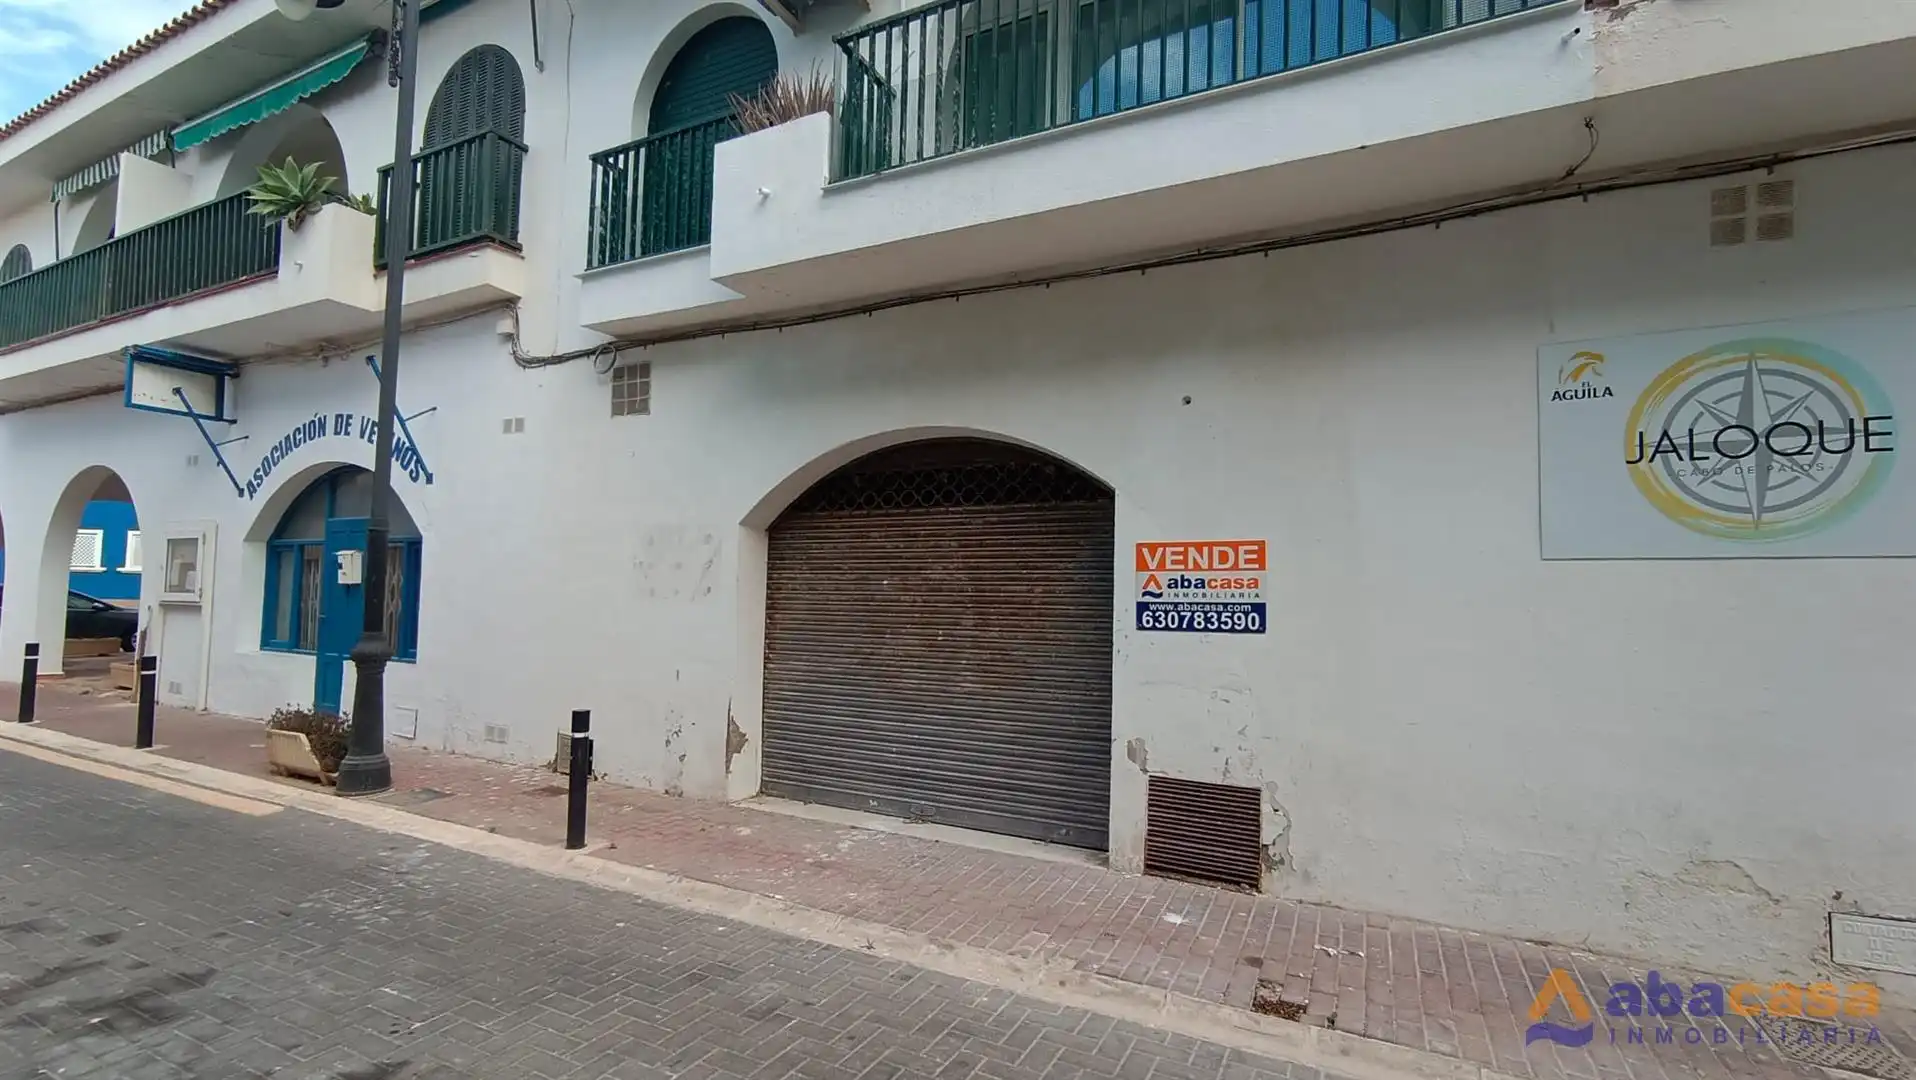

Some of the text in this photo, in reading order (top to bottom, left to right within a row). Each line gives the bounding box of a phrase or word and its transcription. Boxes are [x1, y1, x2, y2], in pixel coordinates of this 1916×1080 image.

[1625, 415, 1895, 465] JALOQUE
[245, 412, 424, 501] ASOCIACIÓN DE VENOS
[1734, 466, 1756, 475] DE
[1141, 545, 1260, 570] VENDE
[1166, 573, 1260, 590] abacasa
[1167, 591, 1261, 599] INMOBILIARIA
[1148, 602, 1252, 612] www.abacasa.com
[1141, 611, 1261, 631] 630783590
